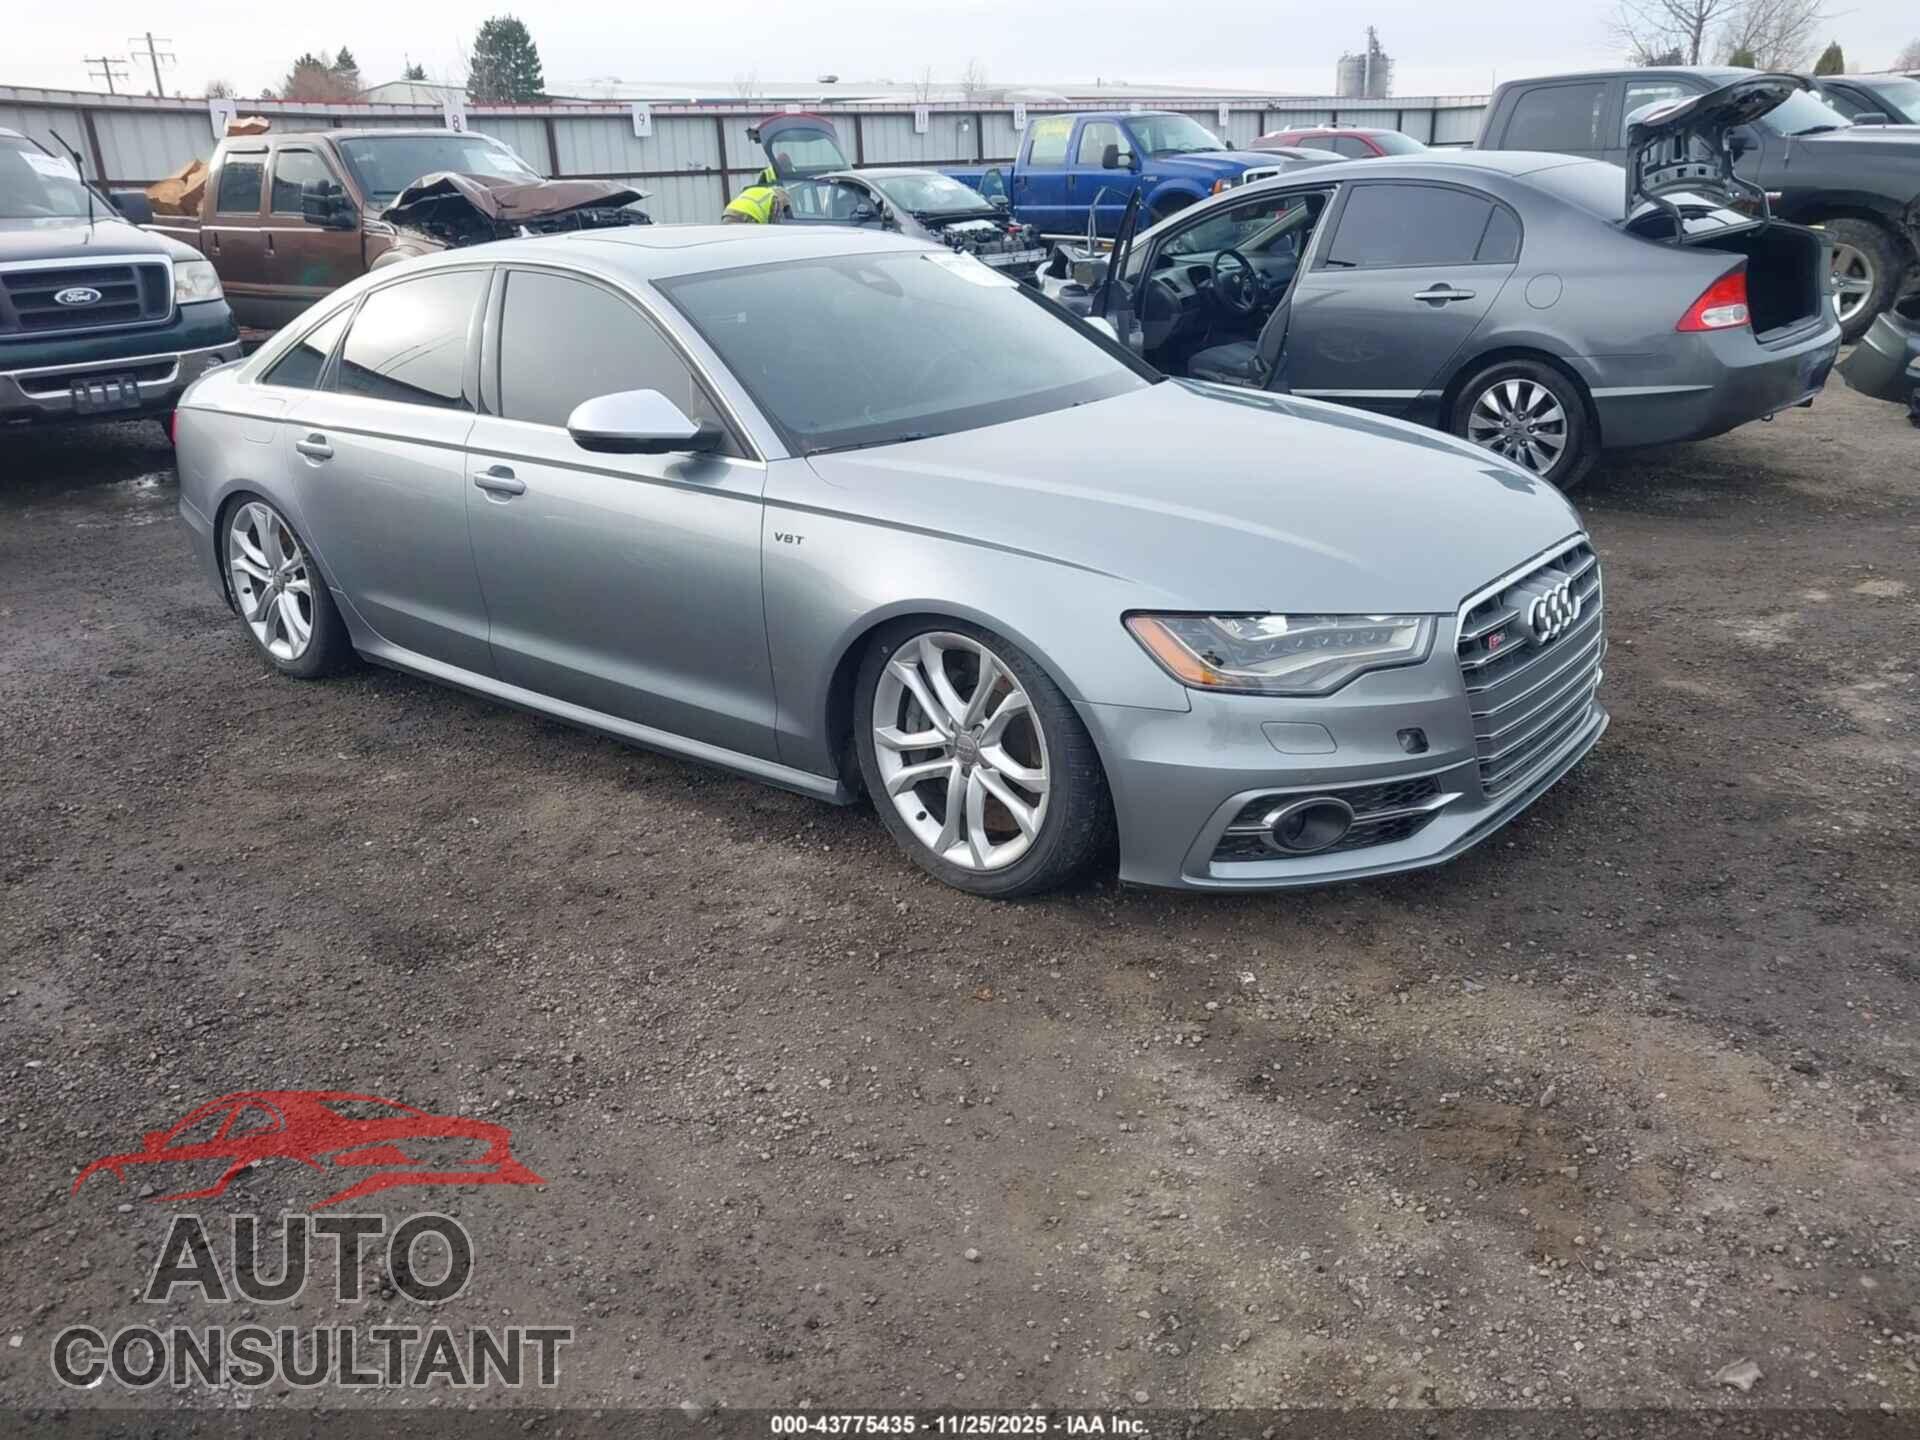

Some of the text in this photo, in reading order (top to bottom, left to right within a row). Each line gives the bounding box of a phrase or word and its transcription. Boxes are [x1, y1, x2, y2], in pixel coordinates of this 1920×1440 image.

[218, 110, 227, 126] 7
[452, 114, 460, 129] 8
[639, 112, 645, 126] 9
[65, 291, 92, 302] Ford
[774, 531, 805, 545] V8T
